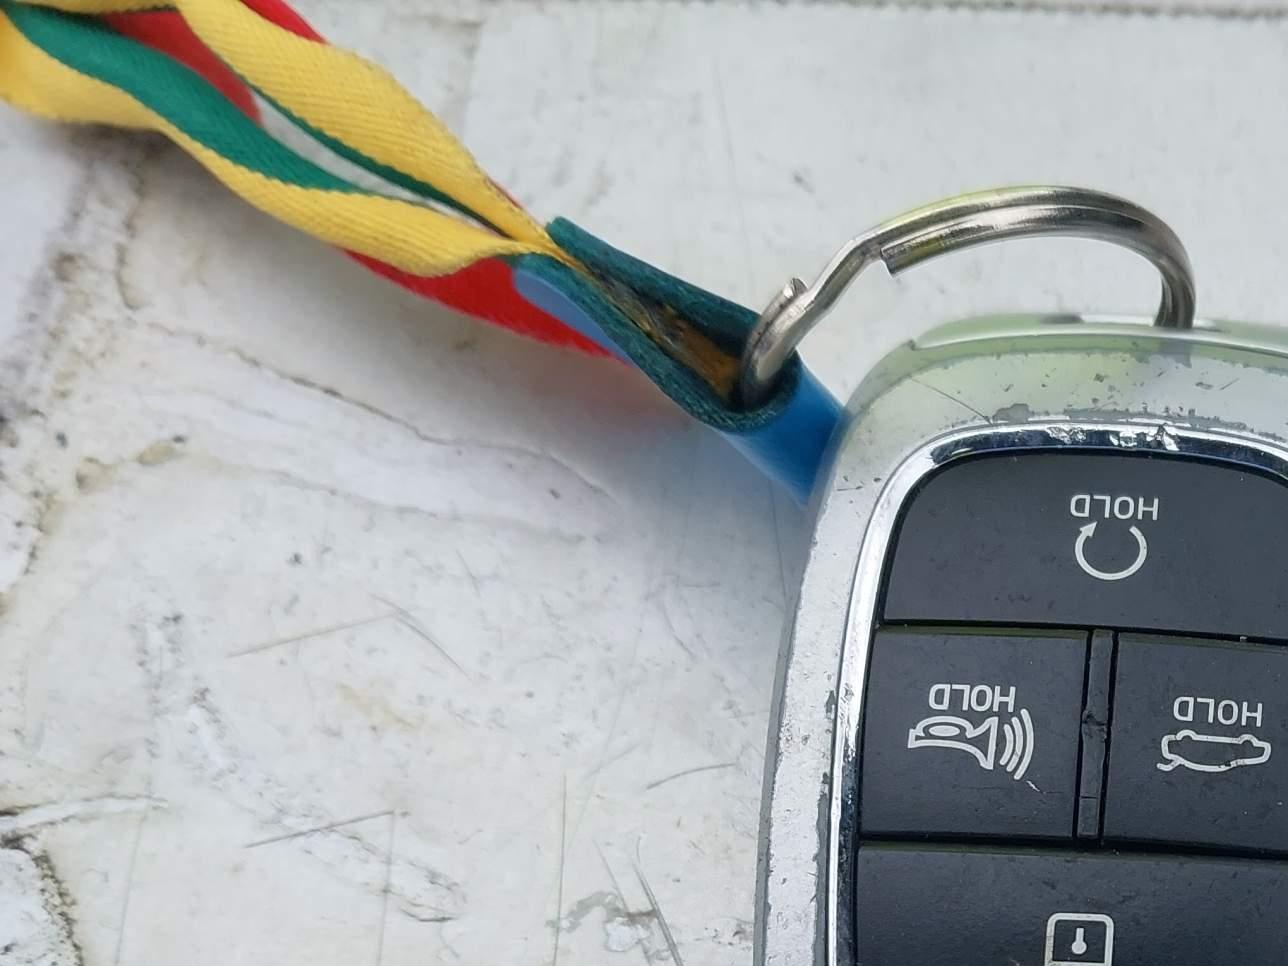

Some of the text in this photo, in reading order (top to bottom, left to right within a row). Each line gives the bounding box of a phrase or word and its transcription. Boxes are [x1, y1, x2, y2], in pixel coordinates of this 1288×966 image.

[1069, 494, 1159, 521] HOLD
[928, 683, 1016, 713] HOLD
[1173, 696, 1263, 727] HOLD
